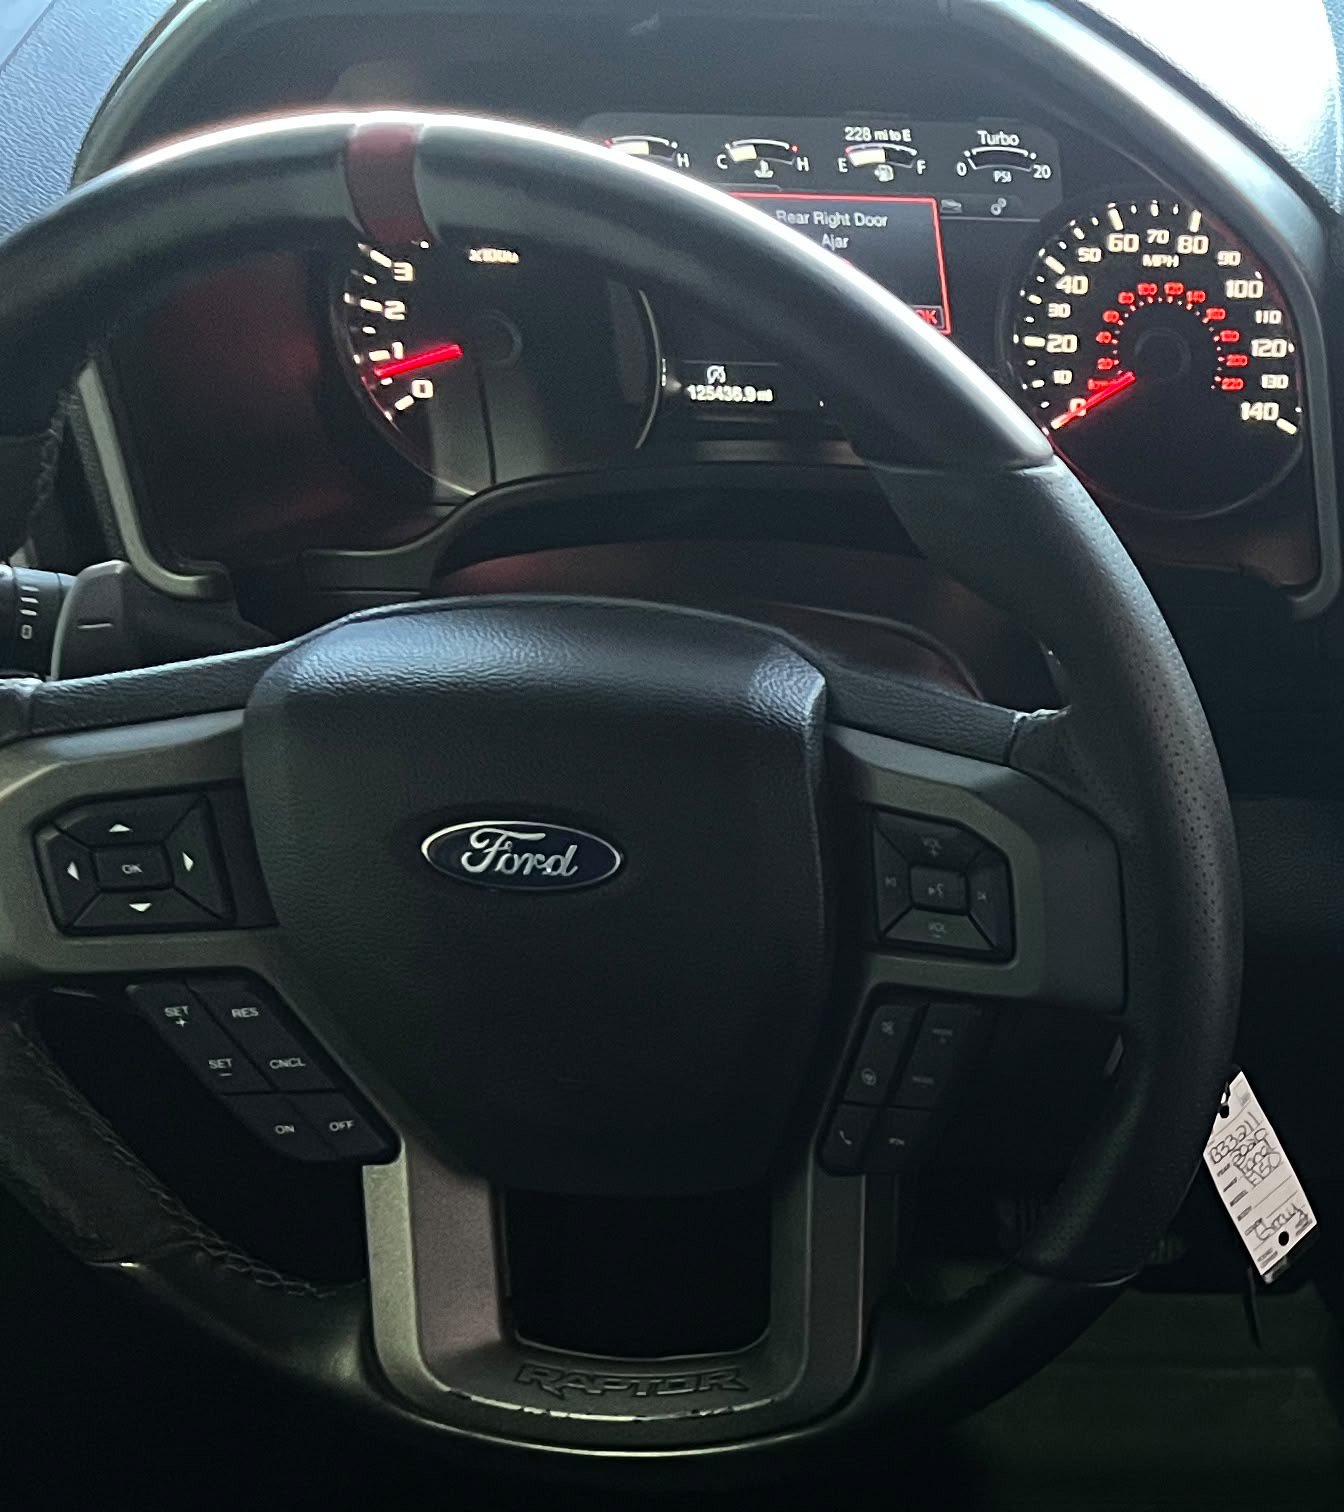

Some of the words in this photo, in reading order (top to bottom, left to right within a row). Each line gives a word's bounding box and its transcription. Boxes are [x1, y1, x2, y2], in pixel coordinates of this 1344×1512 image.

[845, 127, 871, 141] 228
[874, 128, 888, 140] mi
[889, 128, 901, 140] to
[902, 128, 911, 141] E
[976, 130, 1019, 146] Turbo
[676, 153, 690, 168] H
[716, 154, 728, 169] C
[796, 156, 809, 172] H
[838, 157, 848, 172] E
[916, 159, 926, 175] F
[956, 162, 967, 176] 0
[993, 171, 1011, 183] PSI
[1033, 164, 1051, 179] 20
[775, 210, 810, 224] Rear
[813, 211, 851, 229] Right
[854, 212, 888, 227] Door
[821, 233, 849, 250] Ajar
[1107, 233, 1139, 253] 60
[1146, 228, 1170, 244] 70
[1176, 235, 1209, 255] 80
[1077, 247, 1102, 263] 50
[1142, 254, 1179, 268] MPH
[1216, 250, 1241, 266] 90
[393, 262, 414, 281] 3
[1055, 275, 1089, 295] 40
[1224, 279, 1264, 299] 100
[384, 300, 405, 320] 2
[1047, 302, 1071, 318] 30
[1255, 309, 1282, 324] 110
[391, 341, 404, 359] 1
[1046, 334, 1078, 353] 20
[1250, 338, 1287, 358] 120
[1053, 369, 1073, 384] 10
[411, 379, 434, 398] 0
[1240, 402, 1279, 421] 140
[461, 828, 578, 876] Ford
[121, 863, 142, 874] OK
[164, 1006, 189, 1017] SET
[232, 1007, 259, 1018] RES
[208, 1058, 233, 1069] SET
[269, 1058, 306, 1069] CNCL
[274, 1124, 295, 1134] ON
[329, 1120, 353, 1131] OFF
[515, 1361, 748, 1399] RAPTOR
